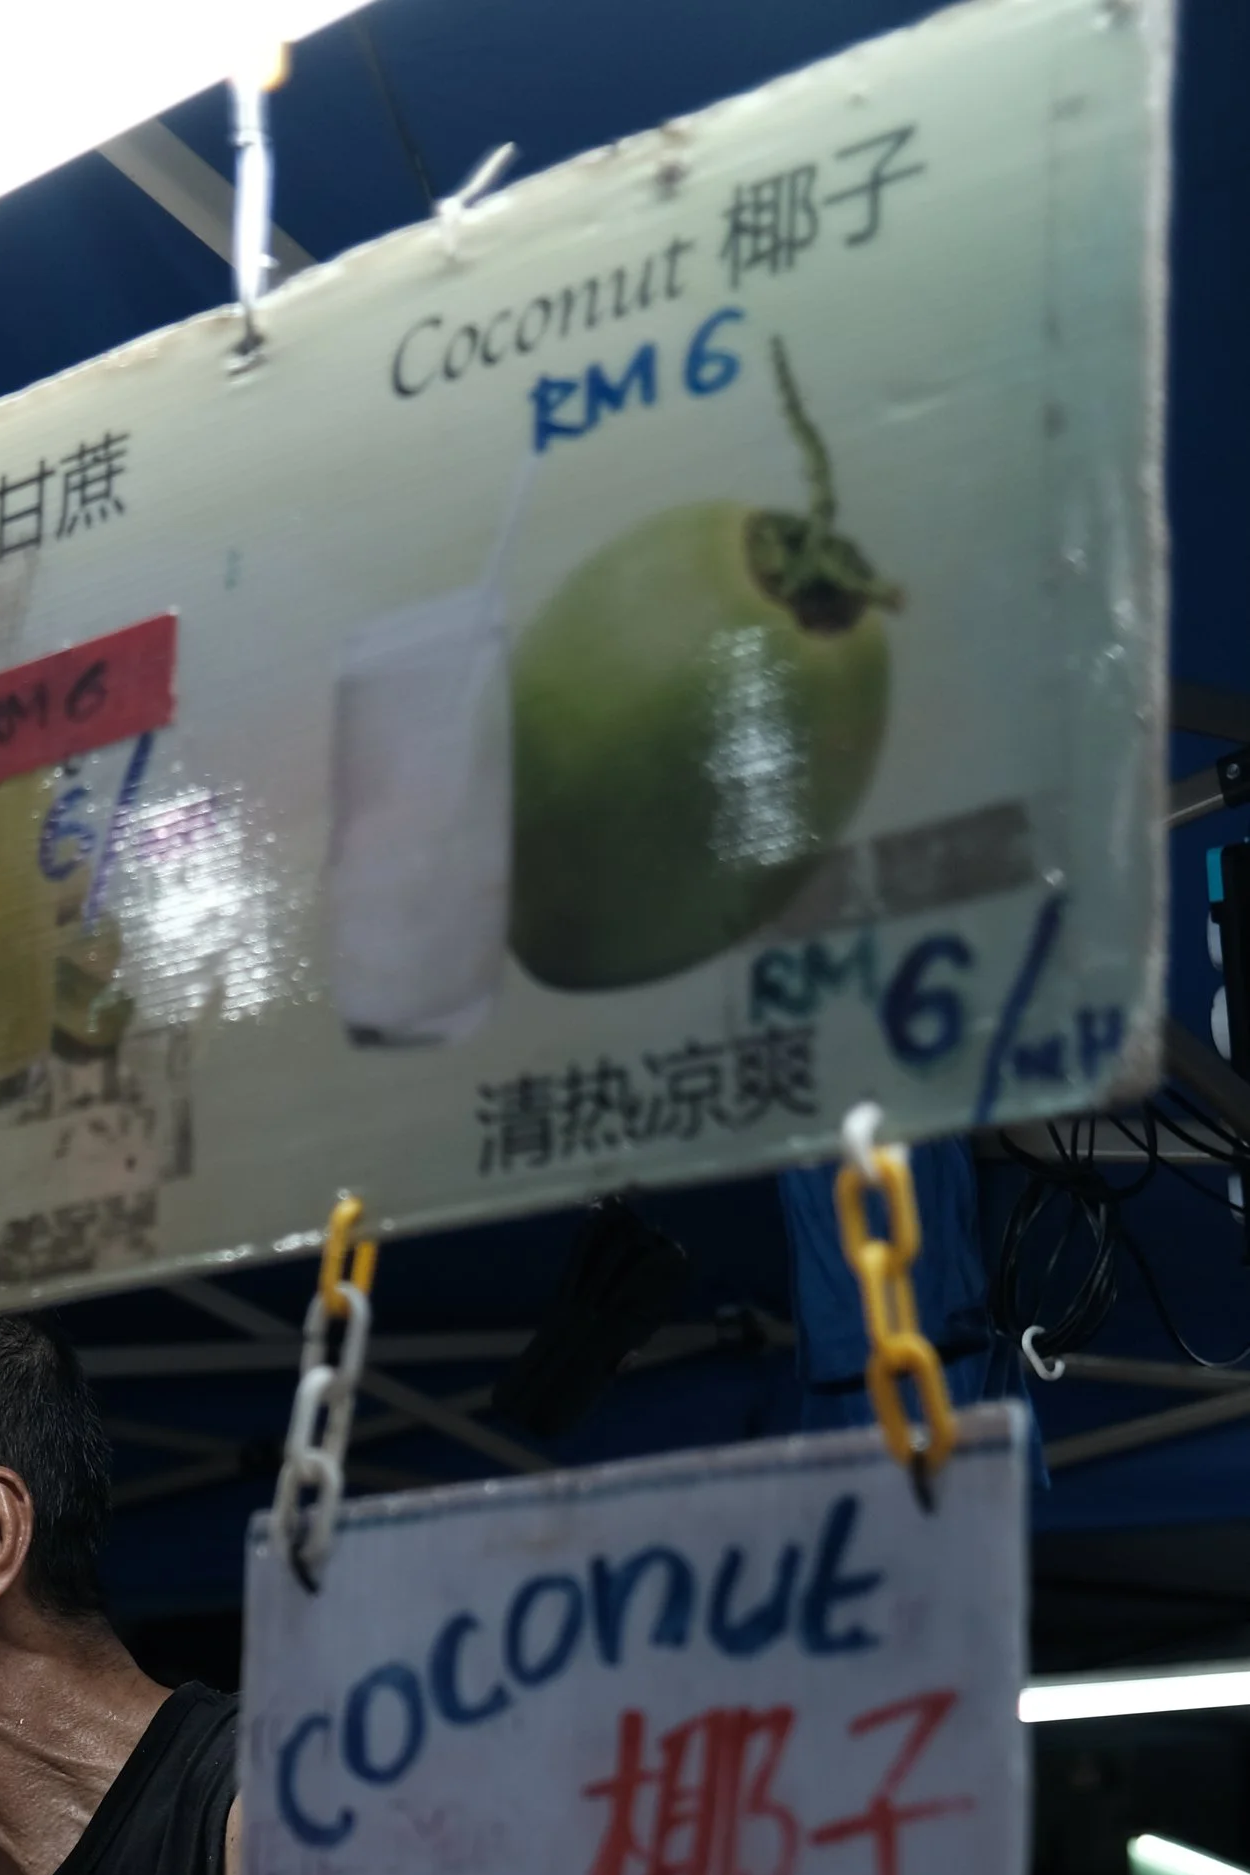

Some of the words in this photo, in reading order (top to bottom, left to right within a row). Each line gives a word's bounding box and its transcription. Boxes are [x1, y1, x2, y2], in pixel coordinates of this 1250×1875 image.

[720, 124, 928, 290] 椰子
[390, 236, 696, 399] Coconut
[530, 340, 658, 454] RM
[683, 307, 746, 397] 6
[475, 1027, 818, 1176] 清热凉爽
